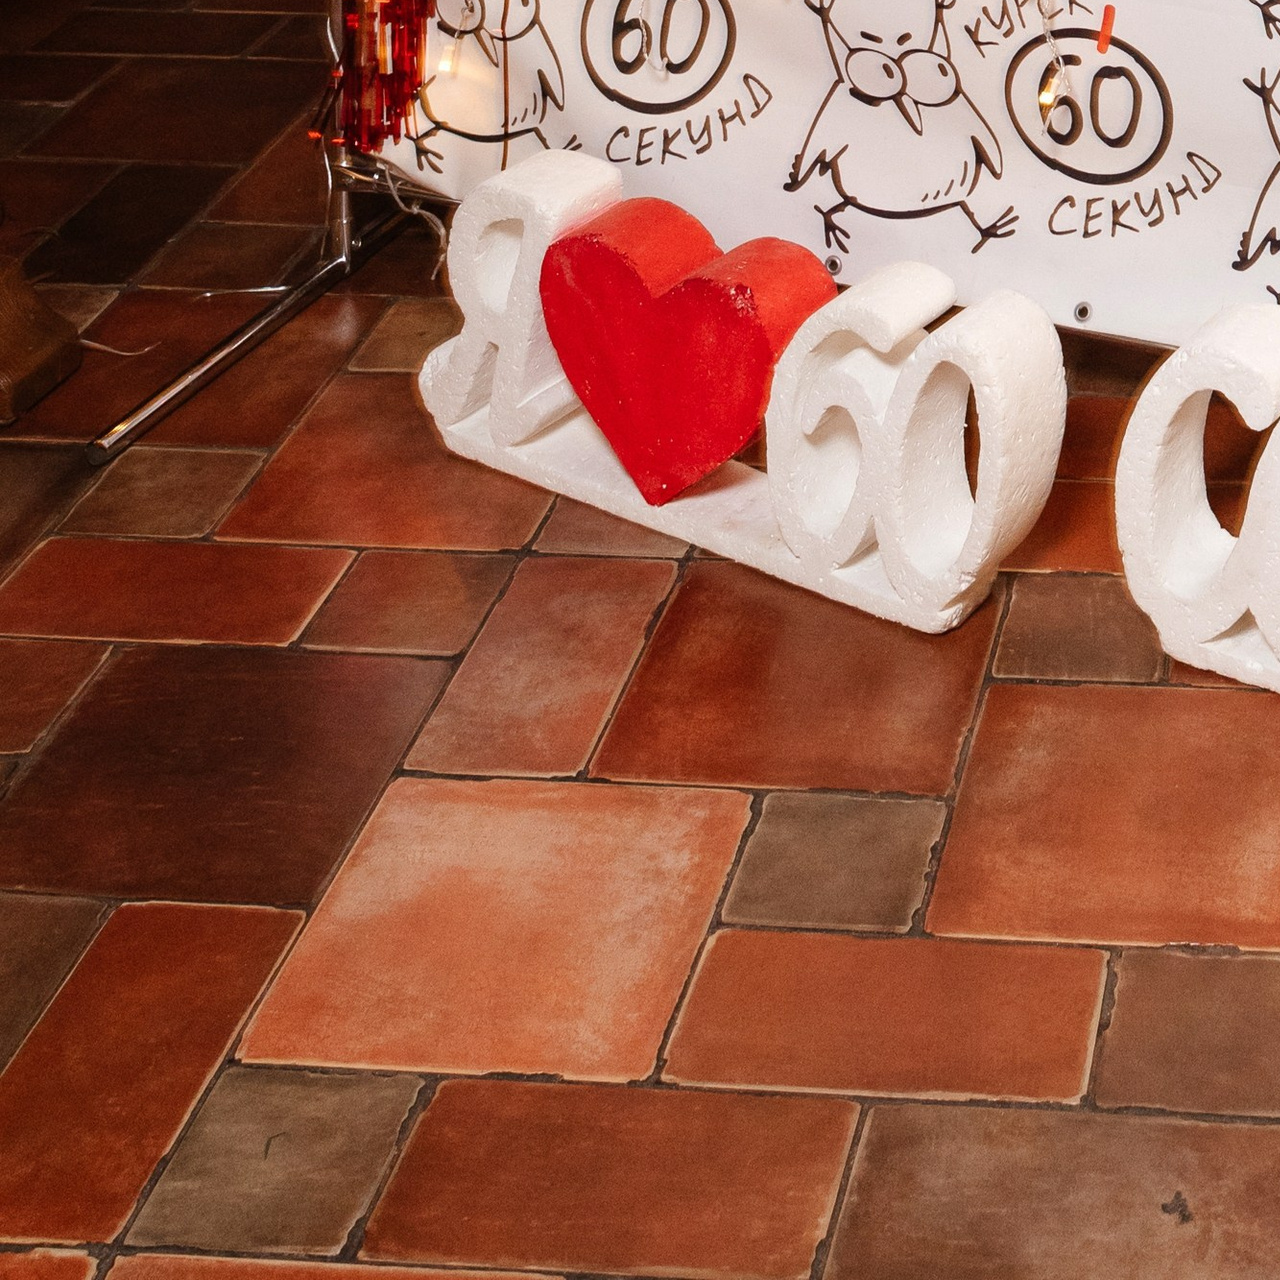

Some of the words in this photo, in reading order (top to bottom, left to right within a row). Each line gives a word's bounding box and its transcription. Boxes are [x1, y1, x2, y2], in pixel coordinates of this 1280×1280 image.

[605, 74, 773, 165] СЕКУНД
[1037, 54, 1142, 148] 60
[1047, 151, 1222, 238] СЕКУНД
[766, 260, 1067, 635] 60
